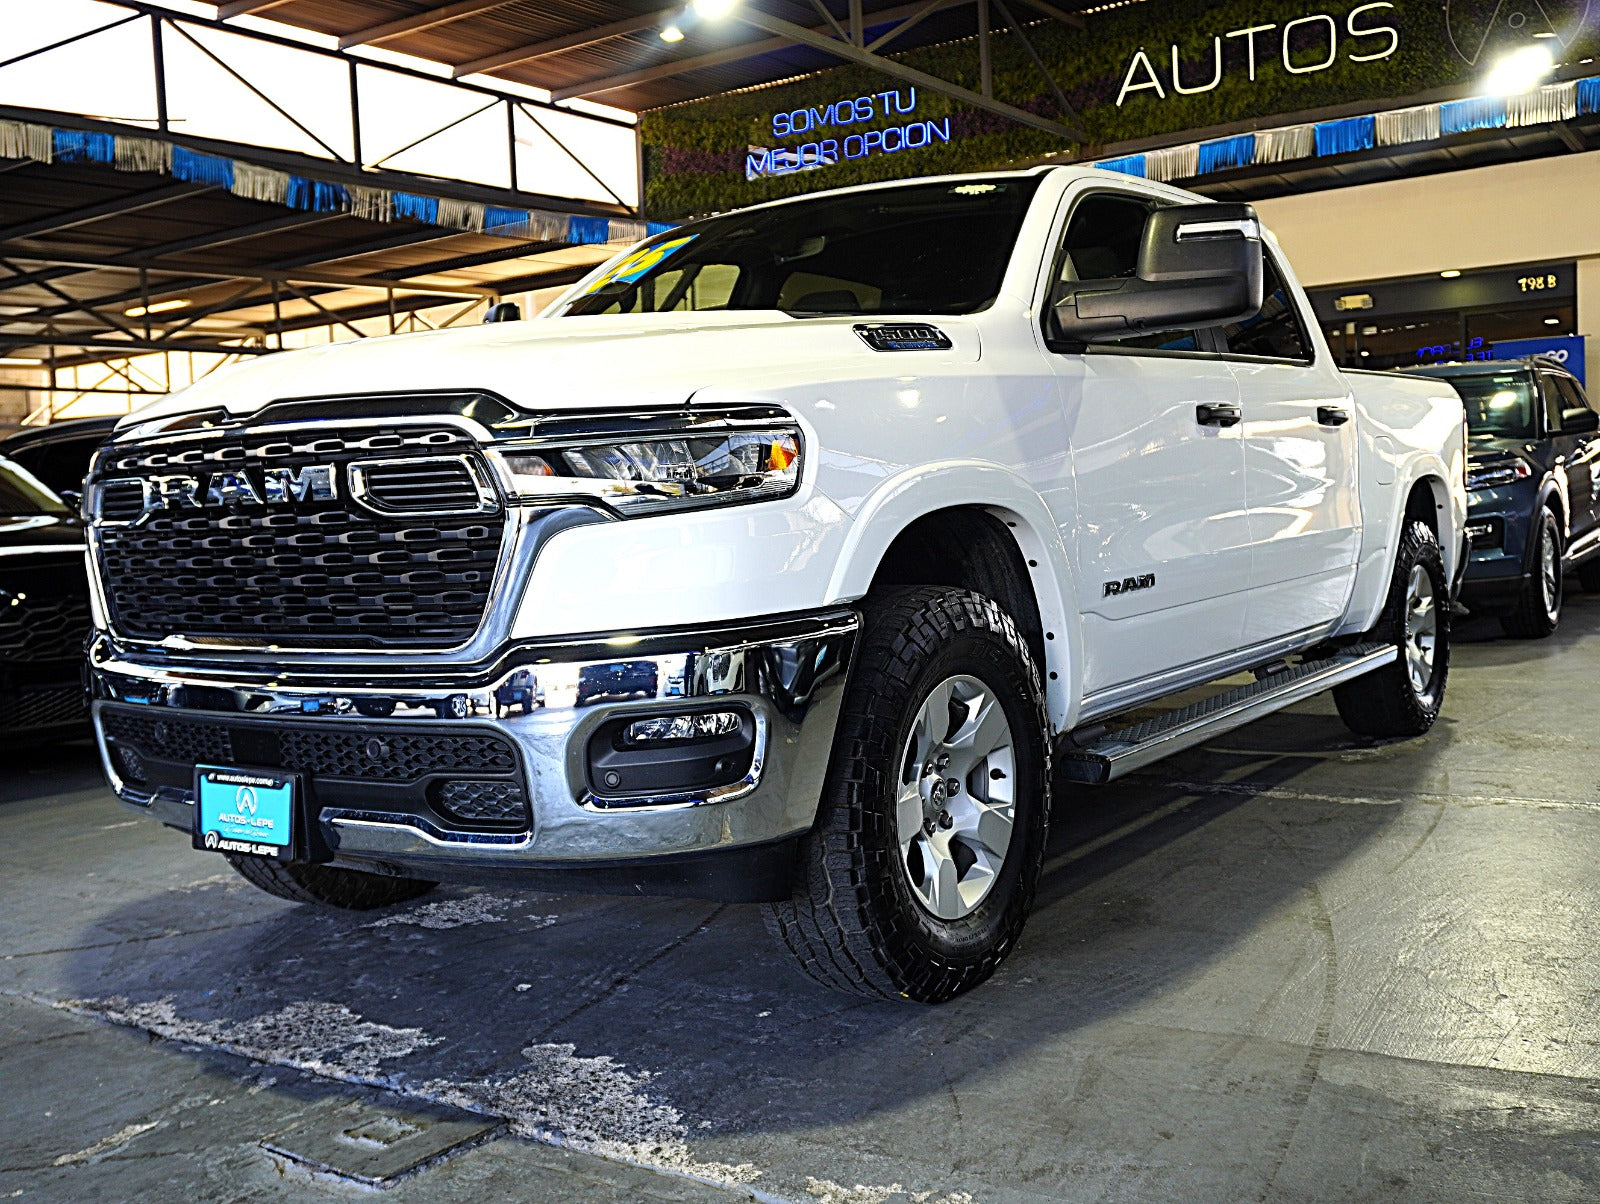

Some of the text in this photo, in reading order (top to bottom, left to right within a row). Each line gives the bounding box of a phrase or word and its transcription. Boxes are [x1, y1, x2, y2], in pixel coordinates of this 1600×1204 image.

[1115, 2, 1399, 107] AUTOS
[771, 86, 916, 138] SOMOS TU
[746, 117, 950, 178] MEJOR OPCION
[1517, 274, 1557, 292] 798 B
[147, 461, 338, 508] RAM
[1102, 572, 1156, 598] RAM
